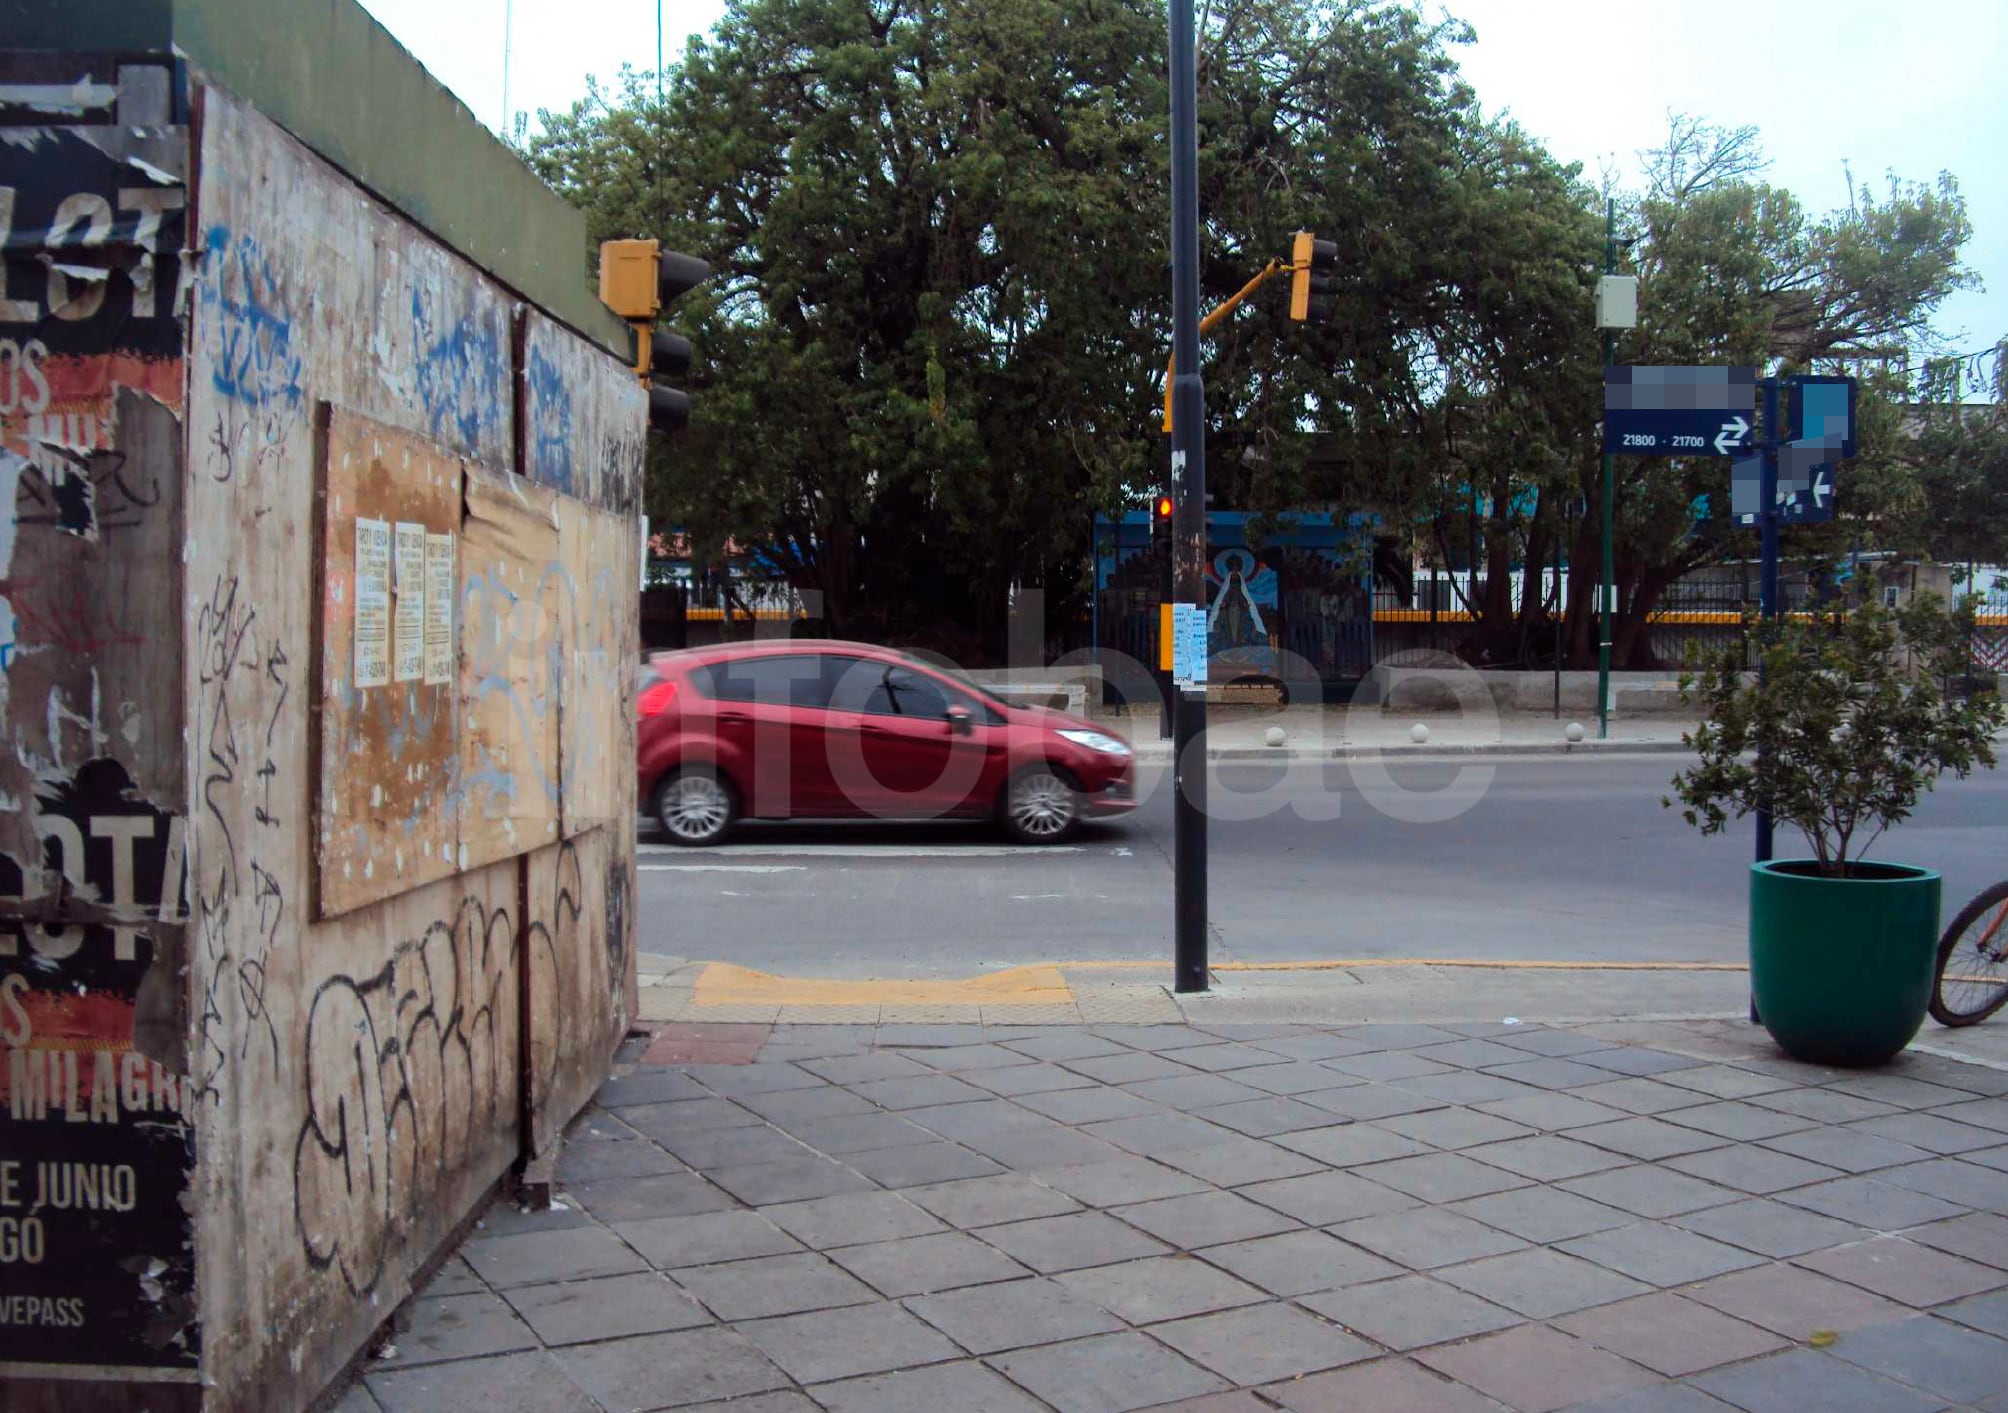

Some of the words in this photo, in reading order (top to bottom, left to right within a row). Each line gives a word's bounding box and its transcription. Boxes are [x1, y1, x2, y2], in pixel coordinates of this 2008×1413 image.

[1623, 434, 1656, 446] 21800
[1672, 436, 1704, 447] 21700
[32, 1162, 136, 1212] JUNIO
